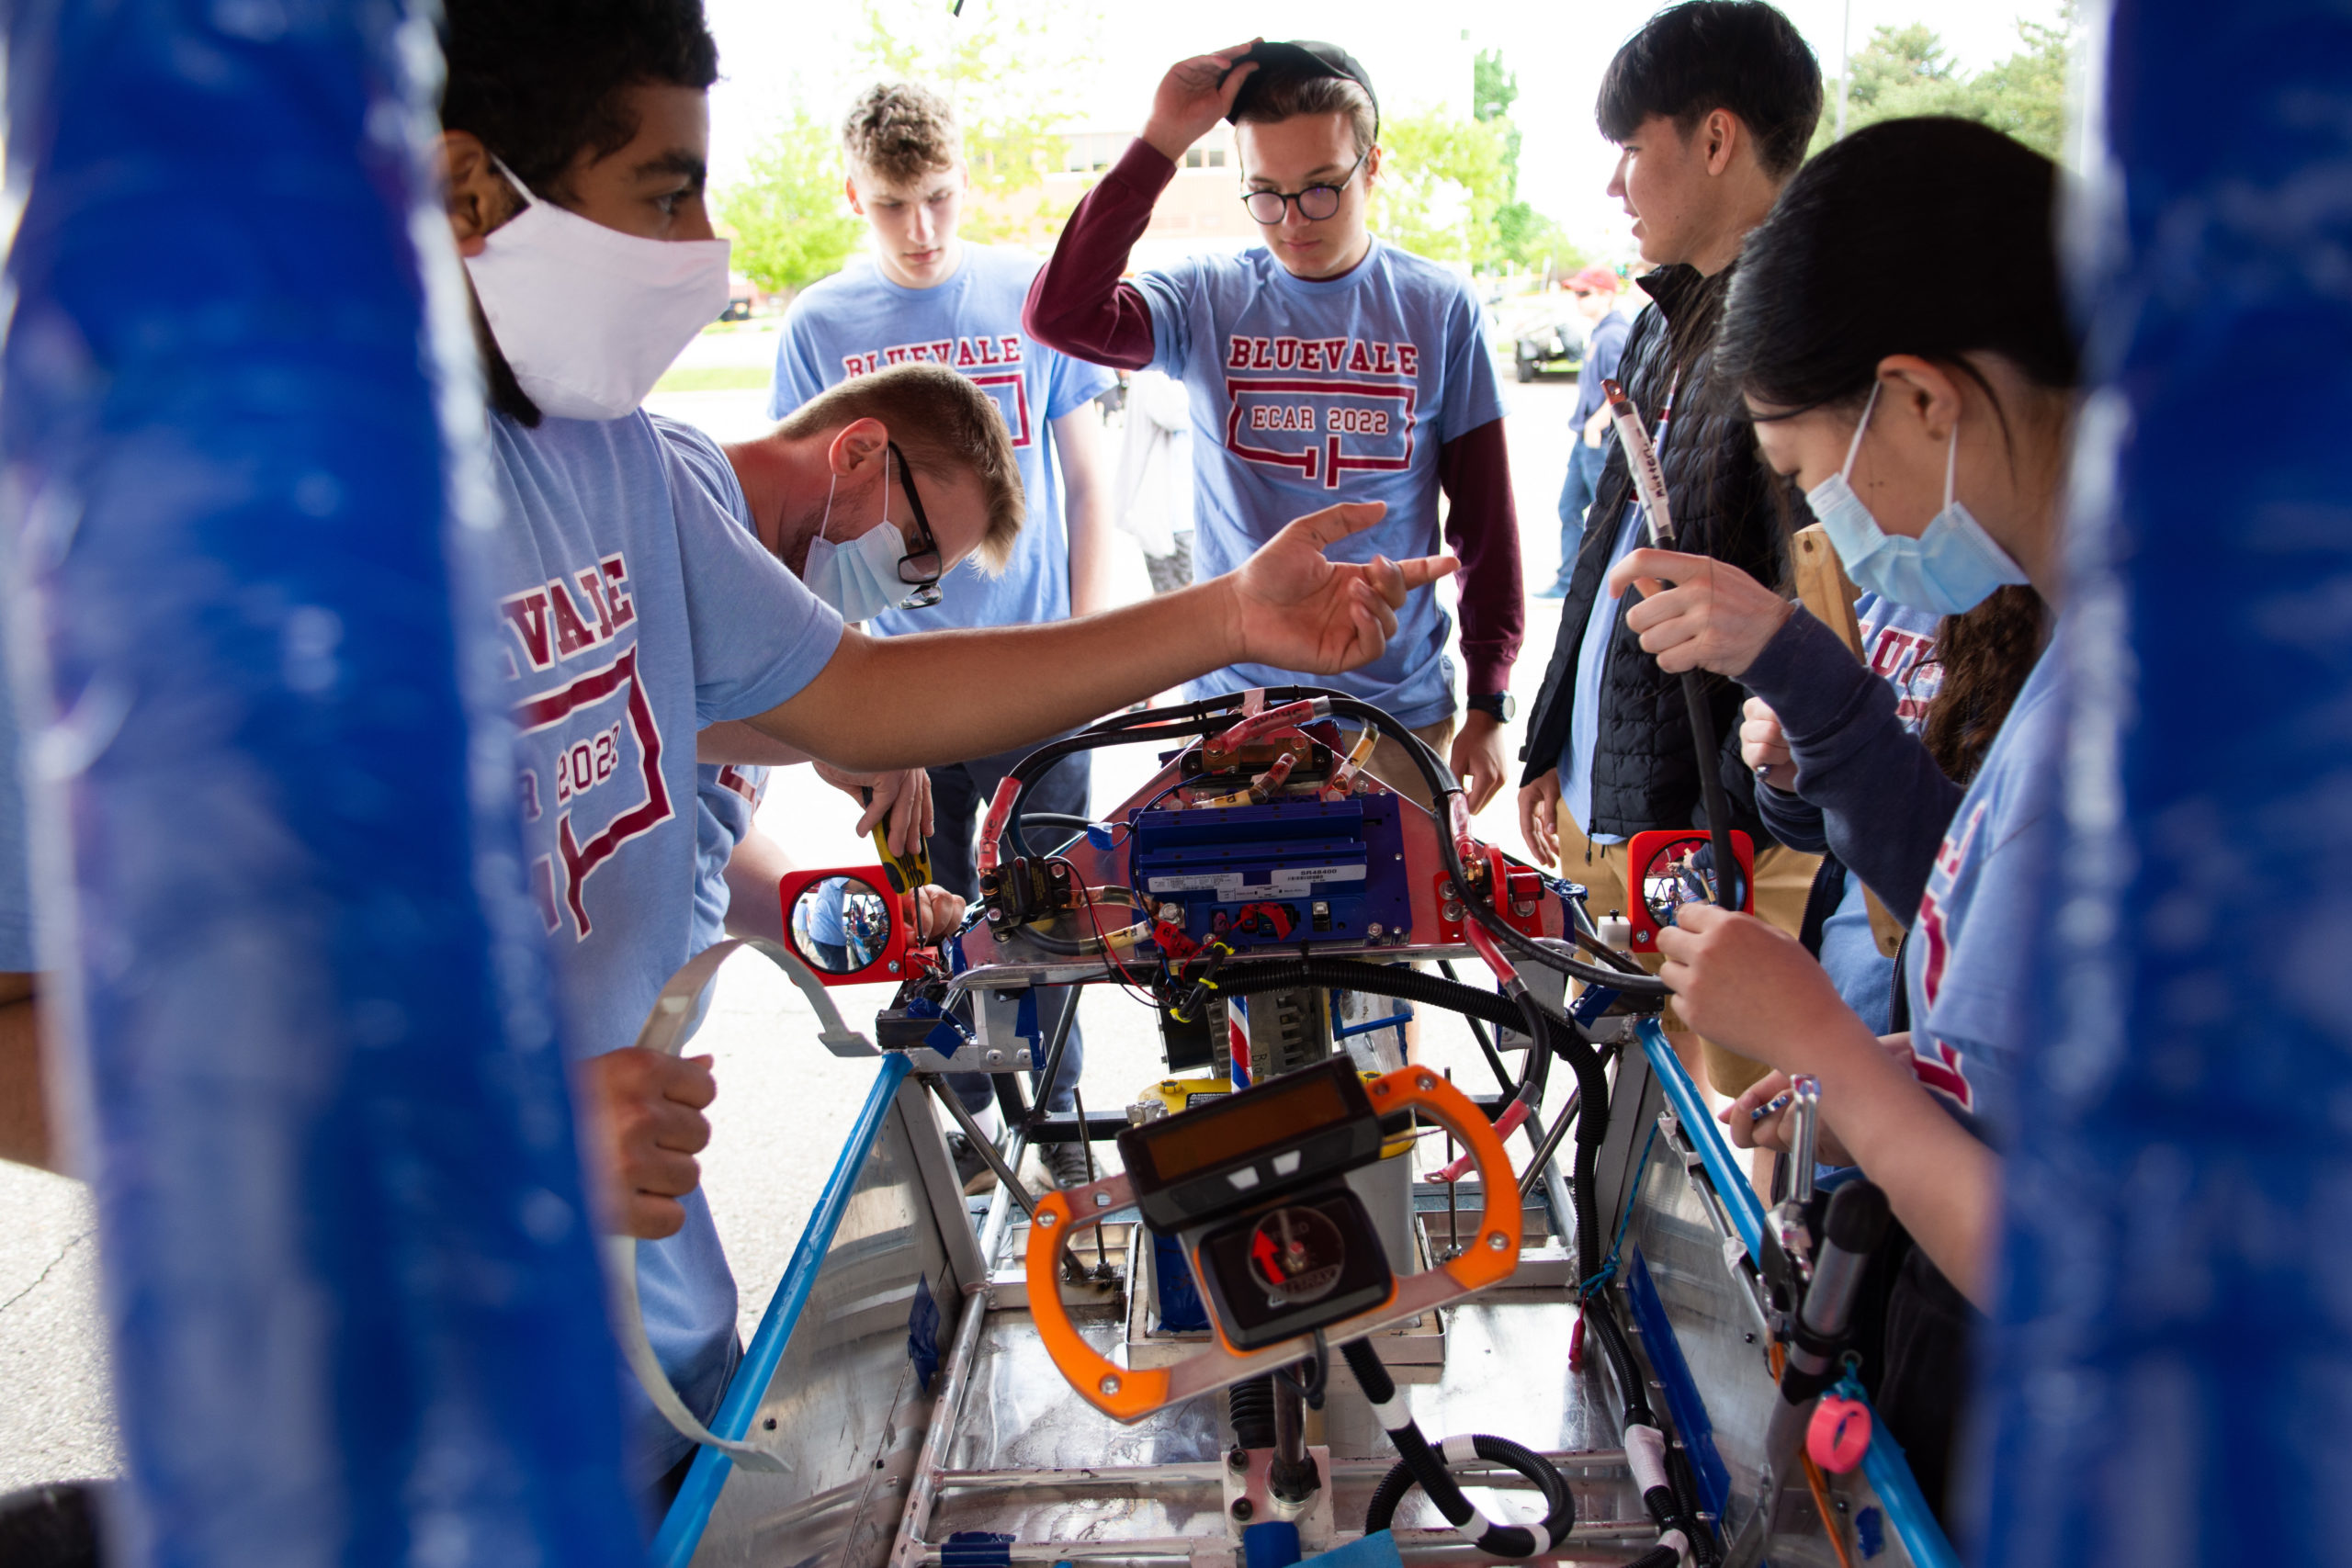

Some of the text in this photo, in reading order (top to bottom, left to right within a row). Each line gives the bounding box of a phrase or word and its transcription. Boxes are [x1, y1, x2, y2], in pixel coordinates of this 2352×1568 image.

[1227, 334, 1419, 378] BLUEVALE
[1250, 405, 1389, 435] ECAR 2022
[1300, 868, 1338, 876] SR48400
